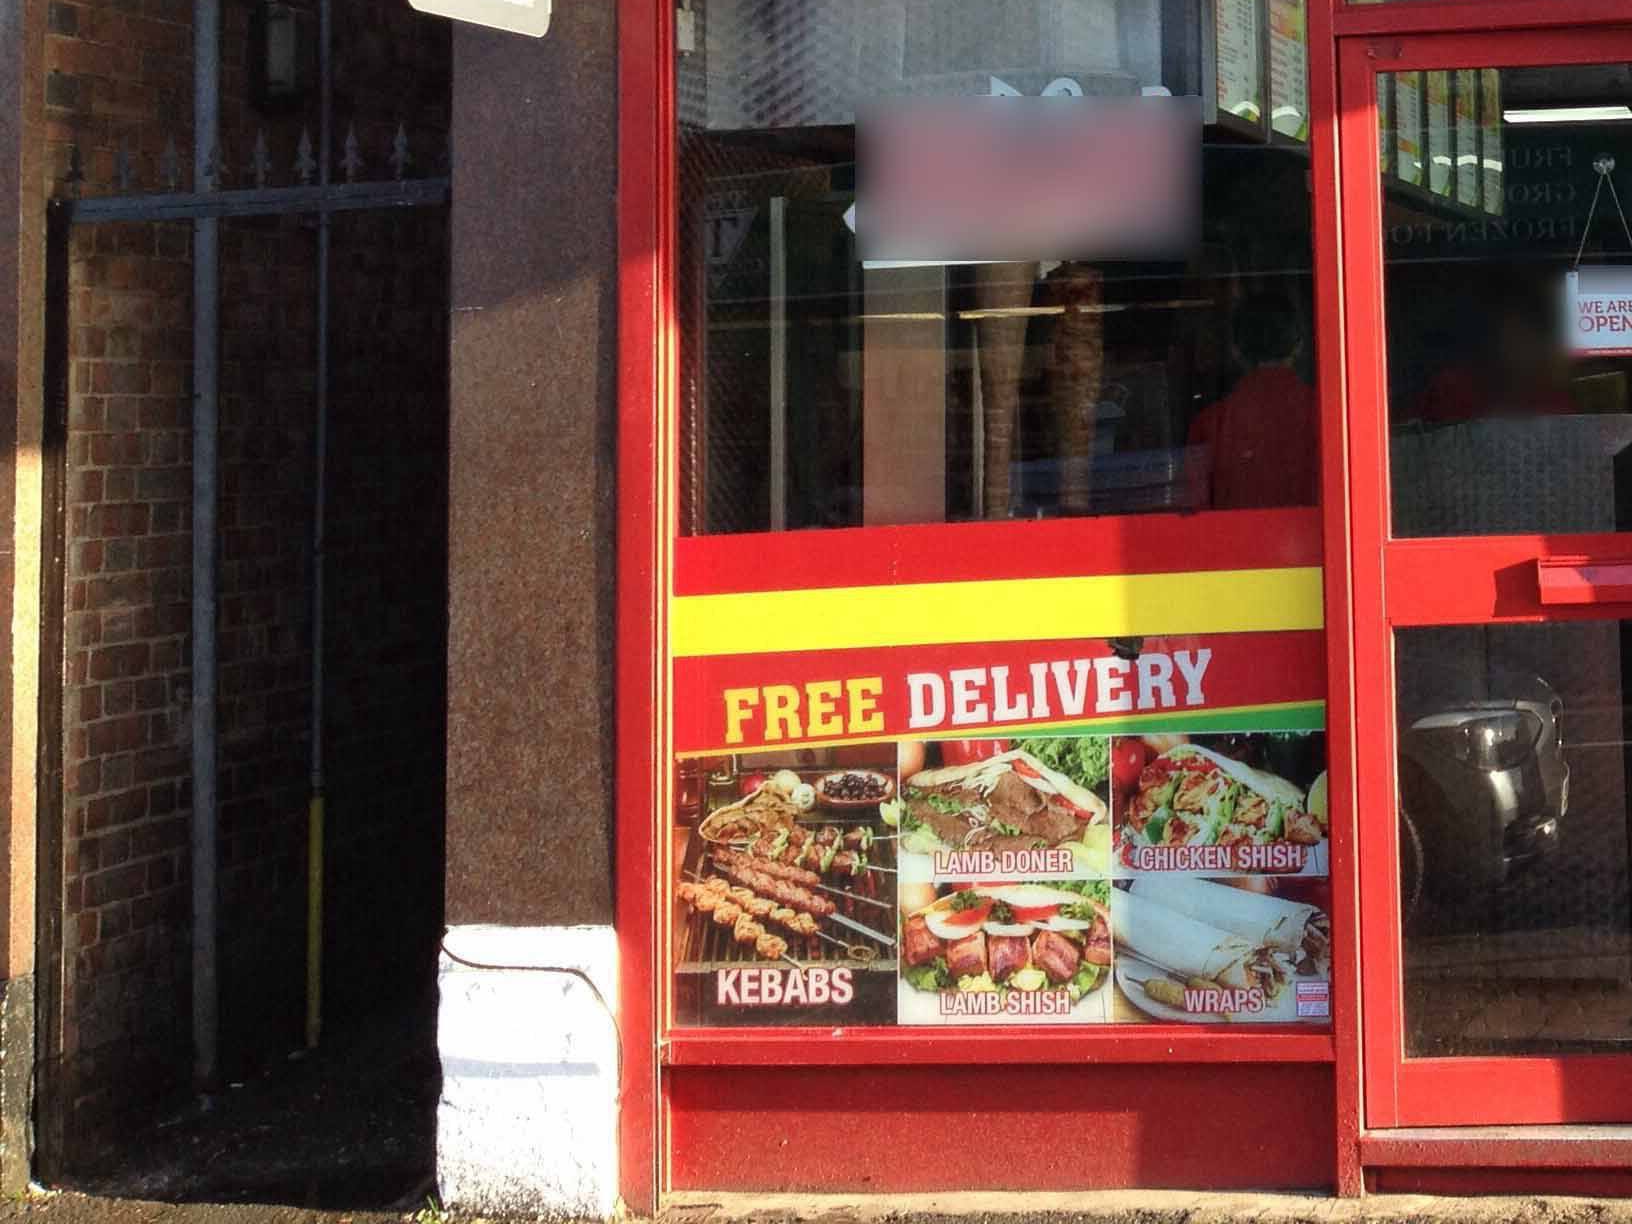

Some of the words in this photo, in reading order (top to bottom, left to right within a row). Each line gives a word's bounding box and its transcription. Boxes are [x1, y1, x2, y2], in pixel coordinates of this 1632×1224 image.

[1578, 301, 1604, 314] WE
[723, 676, 885, 744] FREE
[906, 648, 1213, 729] DELIVERY
[934, 852, 996, 875] LAMB
[1002, 849, 1074, 874] DONER
[1139, 846, 1233, 870] CHICKEN
[1238, 845, 1304, 868] SHISH
[716, 968, 854, 1005] KEBABS
[940, 991, 1003, 1016] LAMB
[1005, 990, 1072, 1015] SHISH
[1184, 989, 1266, 1013] WRAPS
